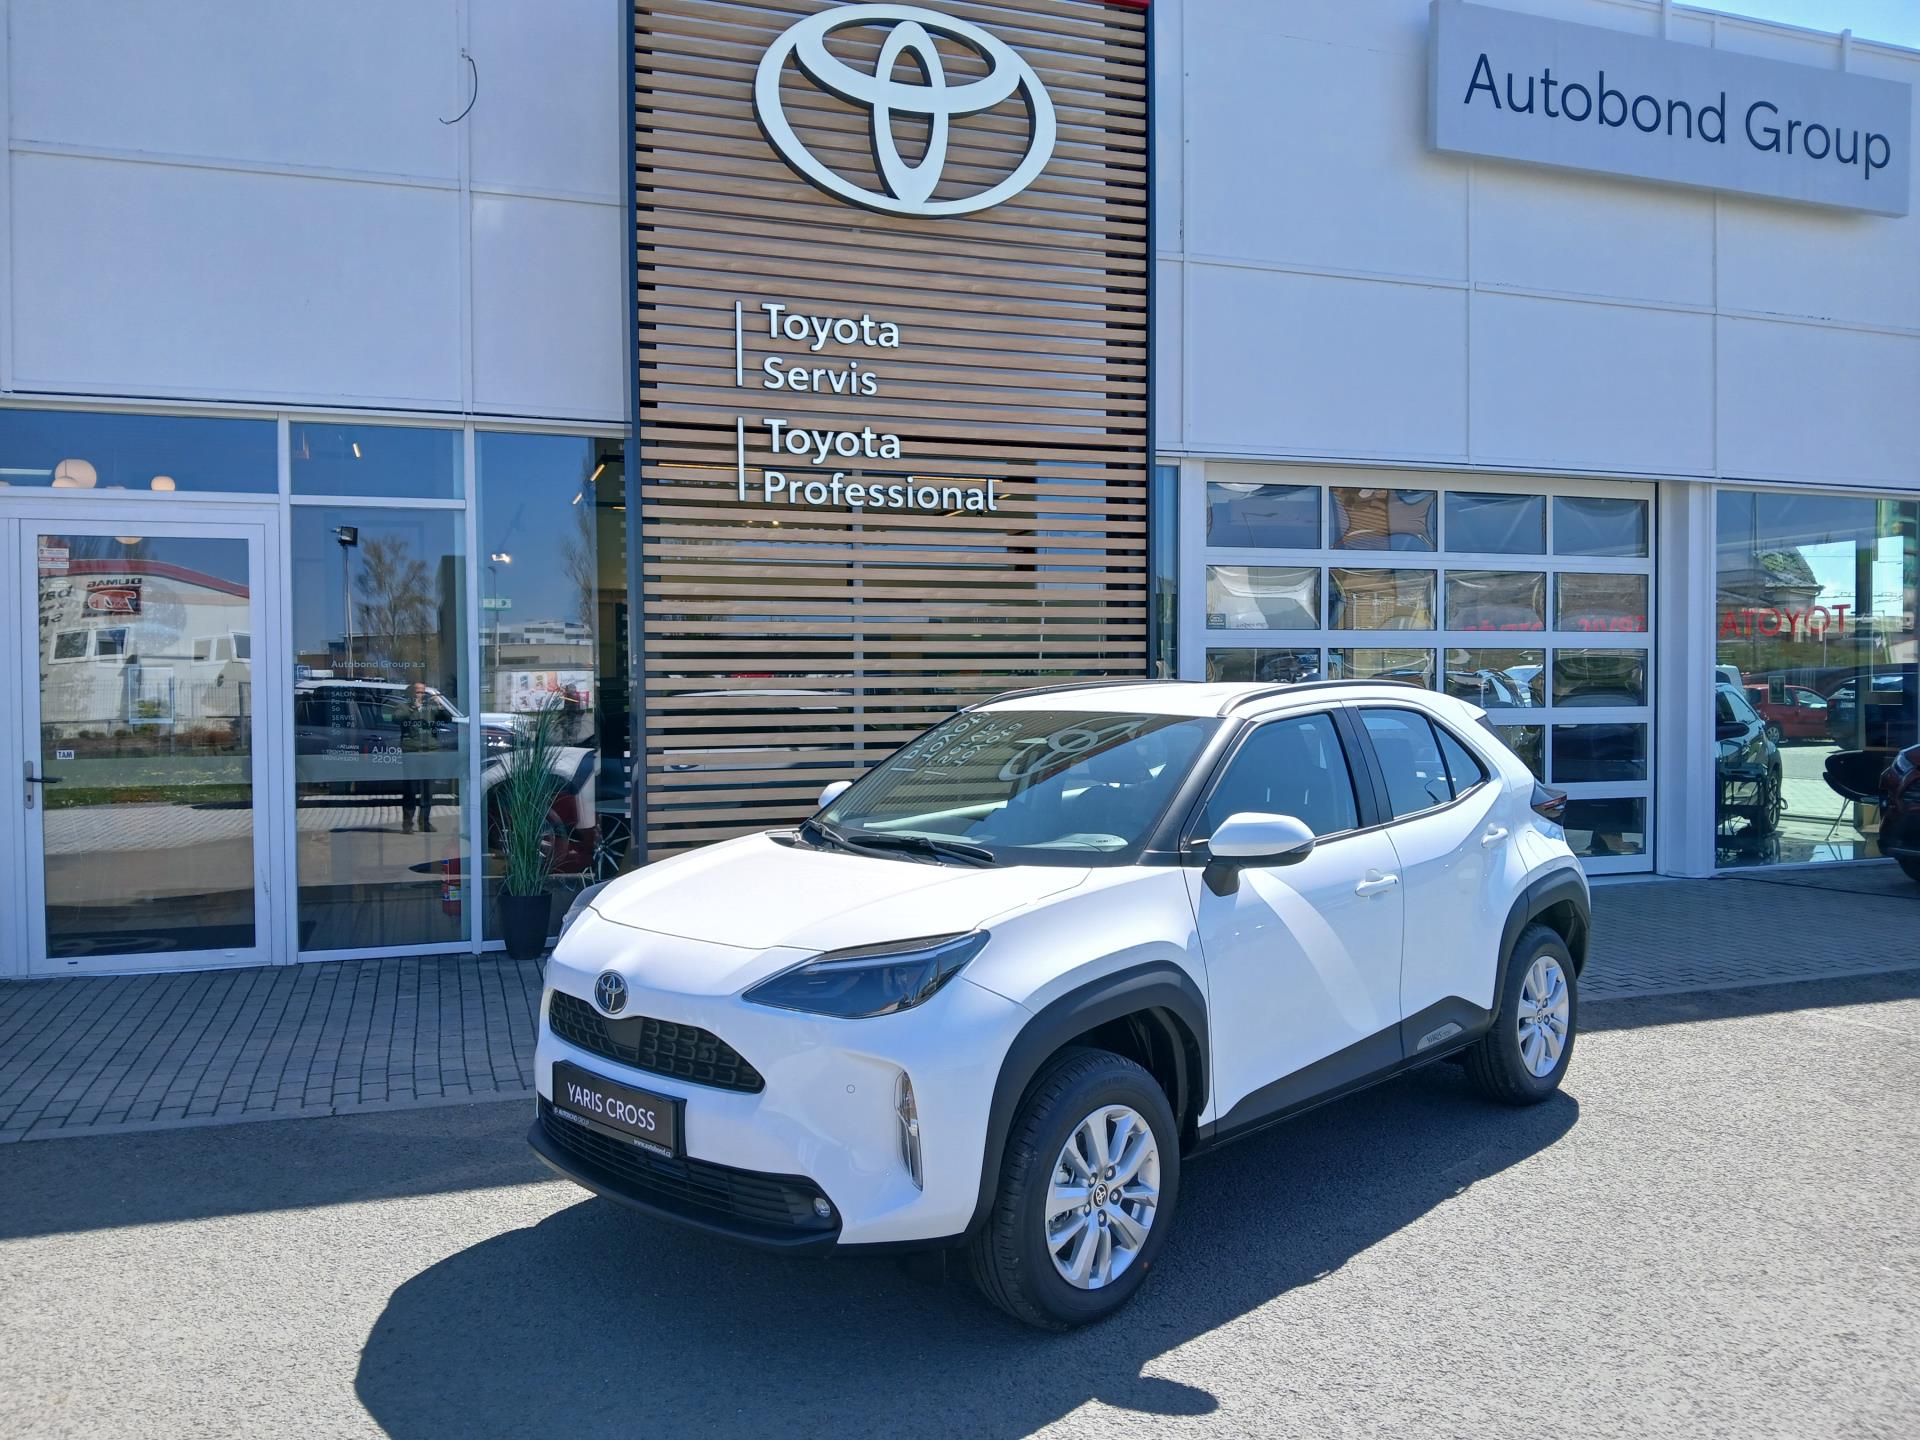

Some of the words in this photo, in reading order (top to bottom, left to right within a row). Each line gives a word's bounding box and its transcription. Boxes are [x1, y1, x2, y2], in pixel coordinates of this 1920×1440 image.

[1463, 53, 1726, 144] Autobond
[1745, 101, 1891, 180] Group
[761, 303, 900, 351] Toyota
[763, 357, 878, 395] Servis
[763, 418, 901, 465] Toyota
[764, 471, 998, 511] Professional
[331, 659, 378, 668] Autobond
[380, 659, 410, 669] Group
[567, 1082, 603, 1113] YARIS
[606, 1098, 656, 1132] CROSS
